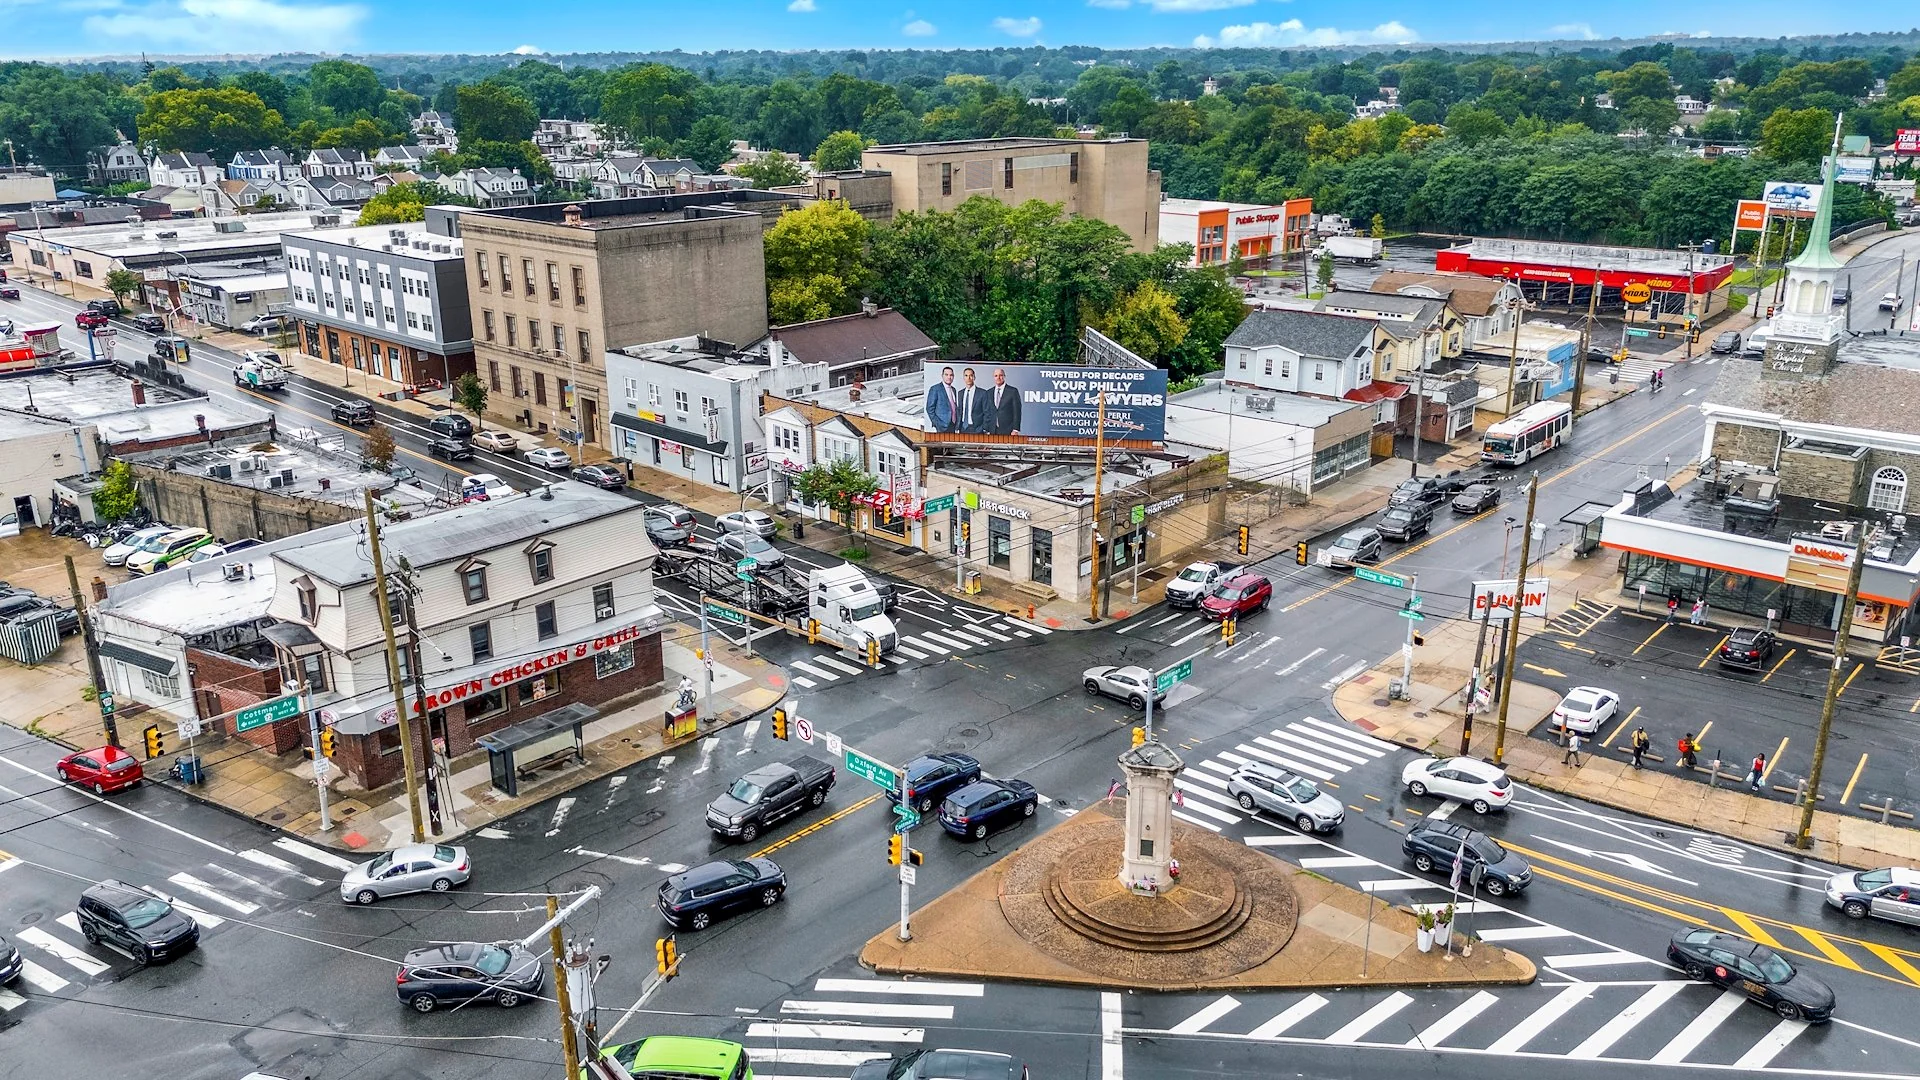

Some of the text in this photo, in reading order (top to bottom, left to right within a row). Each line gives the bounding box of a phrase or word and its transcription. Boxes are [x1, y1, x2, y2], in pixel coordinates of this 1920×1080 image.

[1898, 134, 1917, 142] FEAR
[1235, 213, 1280, 225] Public Storage
[1646, 278, 1672, 288] MIDAS
[1623, 289, 1650, 298] MIDAS
[1040, 370, 1145, 381] TRUSTED FOR DECADES
[1052, 380, 1133, 392] YOUR PHILLY
[1024, 390, 1164, 406] INJURY LAWYERS
[1107, 412, 1131, 420] PERRI
[1051, 419, 1091, 427] MCHUGH
[1078, 428, 1099, 436] DAVI
[1163, 493, 1185, 509] BLOCK
[980, 499, 1030, 520] H&R BLOCK
[1794, 544, 1849, 563] DUNKIN'
[1358, 570, 1401, 586] Rising Sun Av
[490, 650, 569, 688] CHICKEN
[575, 643, 587, 658] &
[593, 625, 640, 651] GRILL
[243, 700, 293, 719] Cottman Av
[854, 756, 877, 773] Oxford
[878, 768, 887, 778] Av
